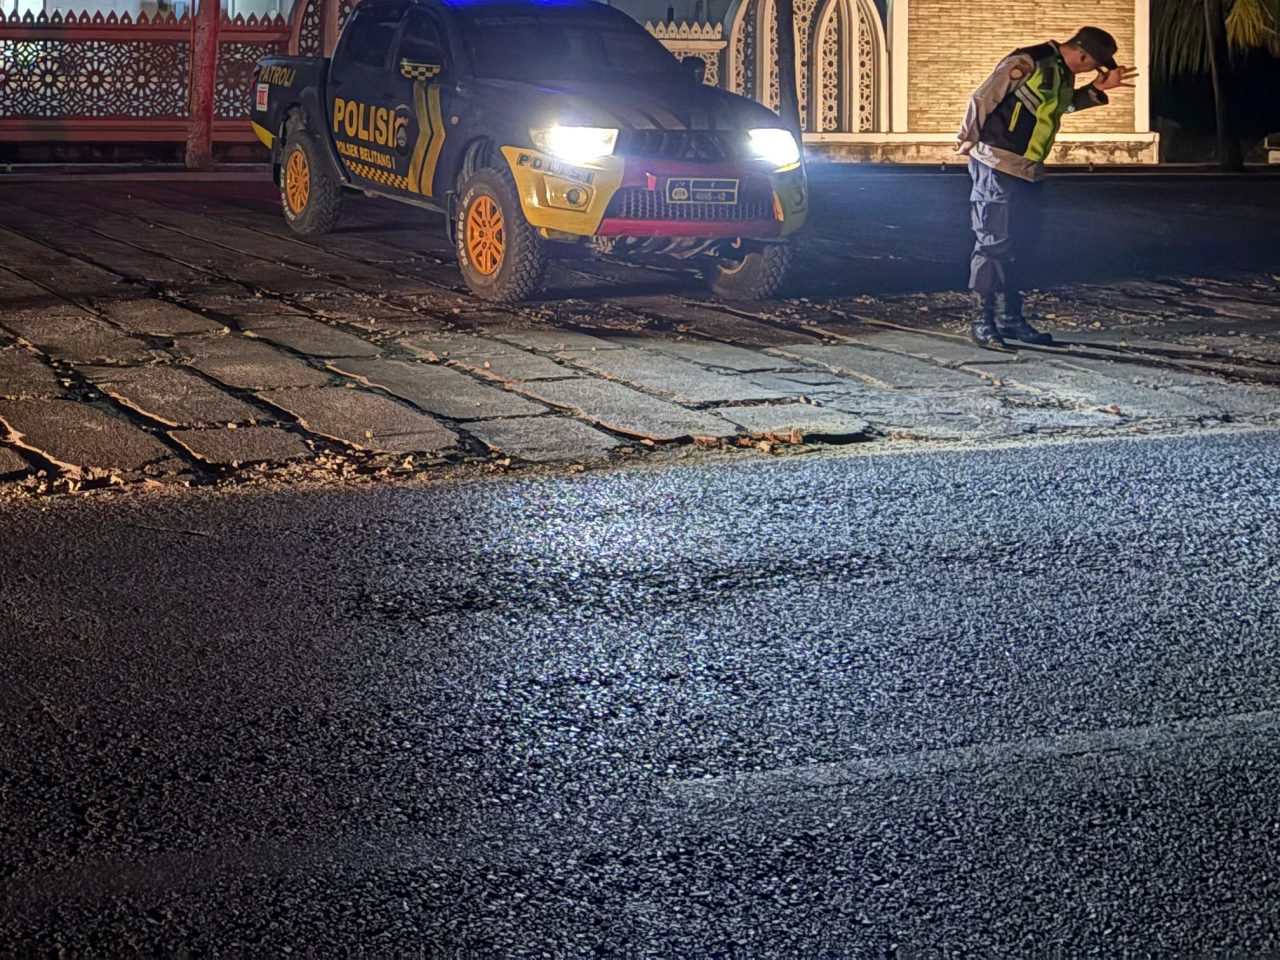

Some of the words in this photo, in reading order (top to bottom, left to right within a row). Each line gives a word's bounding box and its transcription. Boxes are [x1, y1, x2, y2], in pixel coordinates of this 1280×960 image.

[259, 65, 296, 87] PATROLI
[334, 98, 396, 147] POLISI
[336, 141, 360, 157] POLSEK
[360, 145, 392, 169] BELITANG
[516, 152, 595, 185] POLISI
[458, 212, 468, 266] SAVERO
